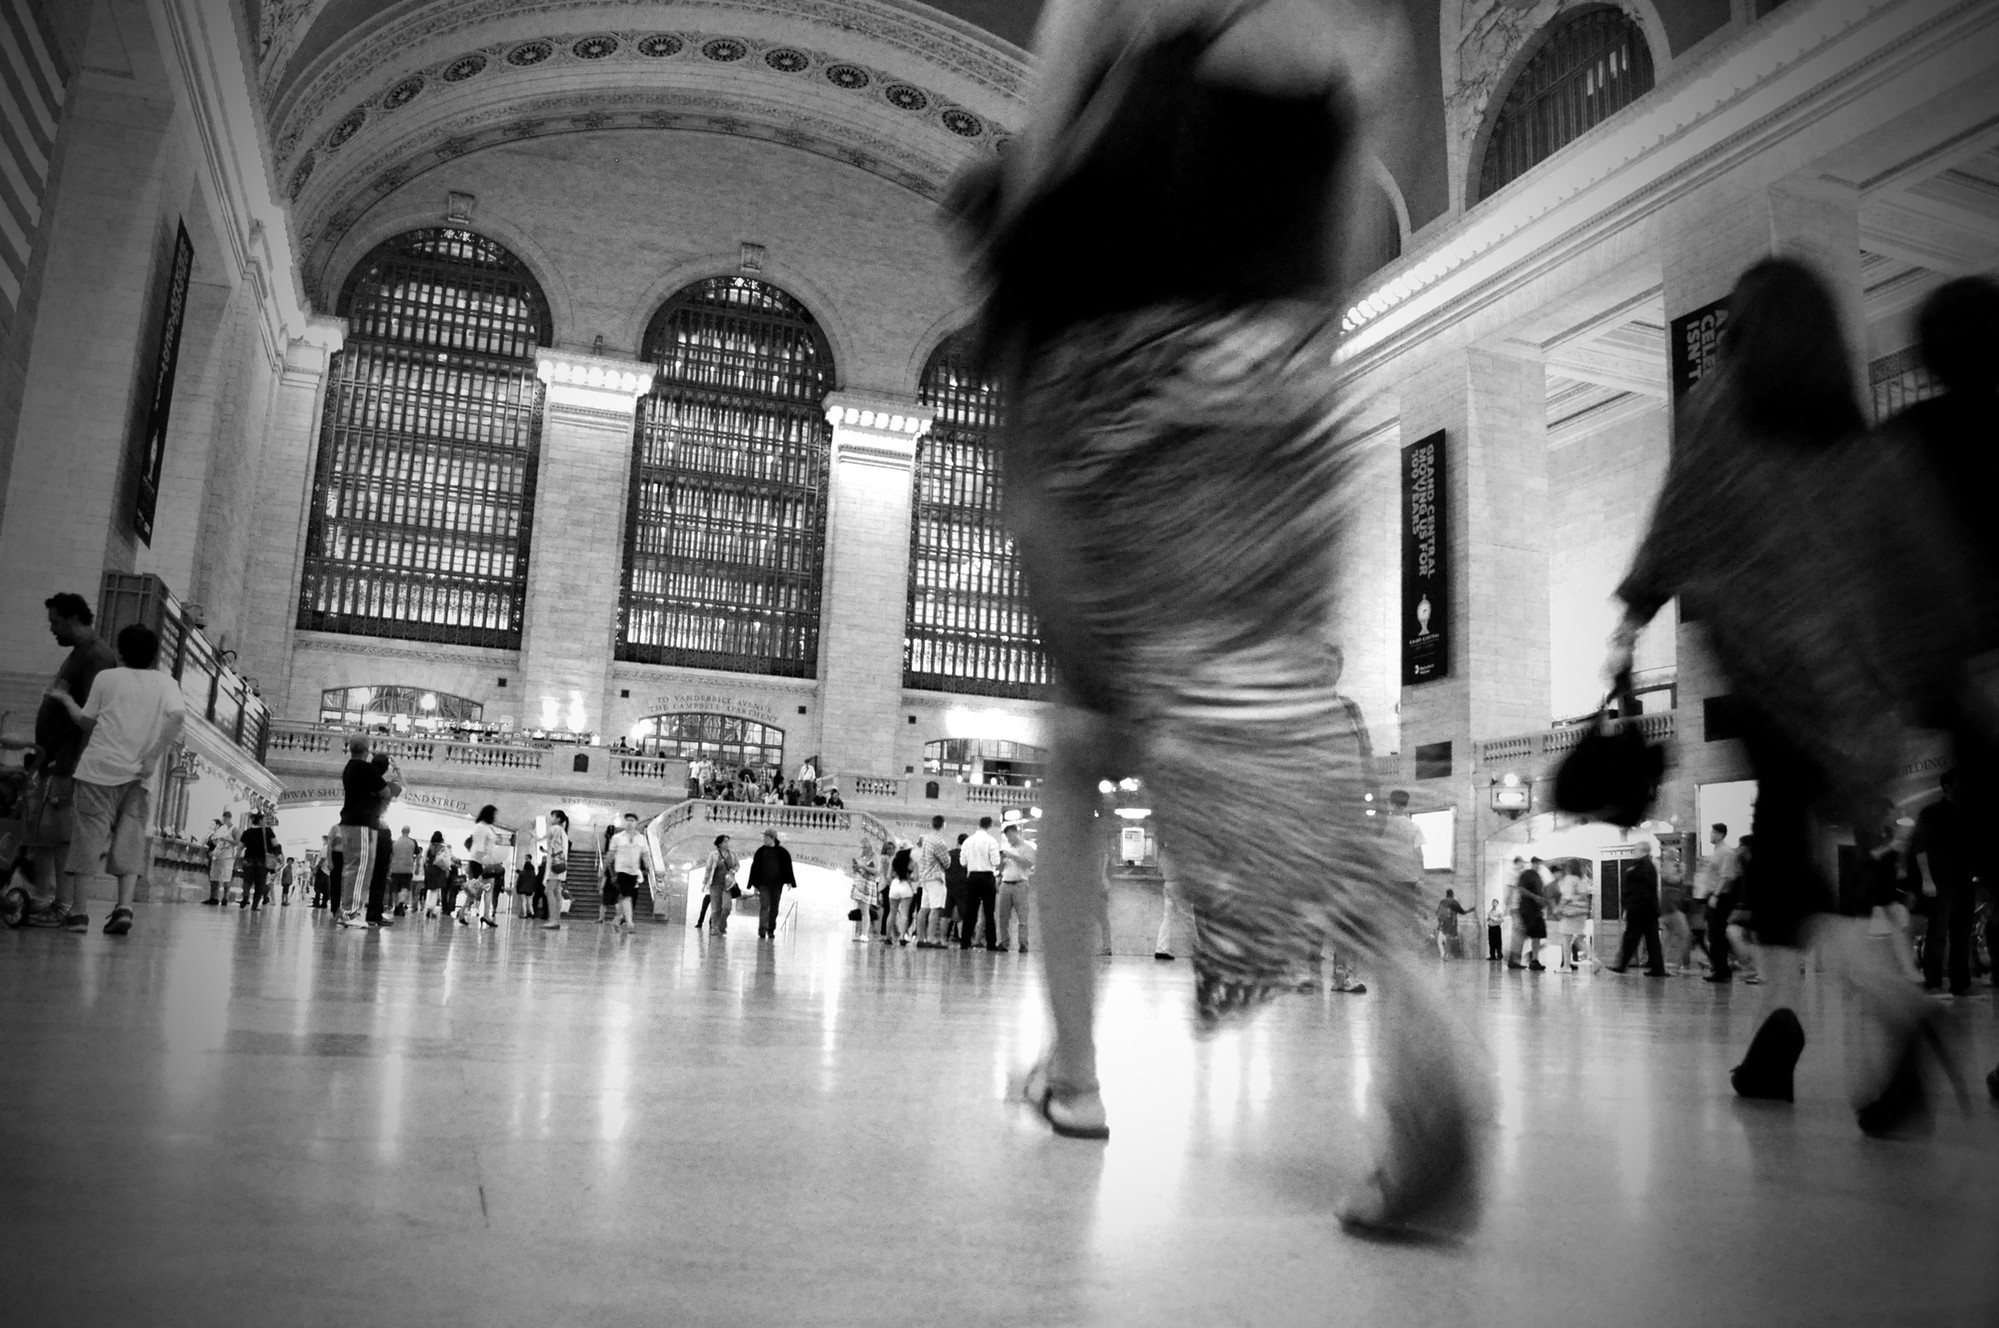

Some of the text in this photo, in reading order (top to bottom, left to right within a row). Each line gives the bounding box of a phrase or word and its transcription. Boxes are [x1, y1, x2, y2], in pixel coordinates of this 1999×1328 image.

[1686, 320, 1703, 379] ISN'T
[1411, 449, 1420, 535] 100 YEARS
[1419, 447, 1429, 577] MOVING US FOR
[1426, 443, 1436, 580] GRAND CENTRAL
[649, 702, 780, 723] THE CAMPBELL APARTMENT
[674, 694, 731, 705] VANDERBILT
[738, 699, 772, 713] AVENUE
[1900, 756, 1947, 776] ILDING
[280, 788, 346, 800] BWAY SHUT
[431, 796, 470, 810] STREET
[915, 821, 932, 830] BALC
